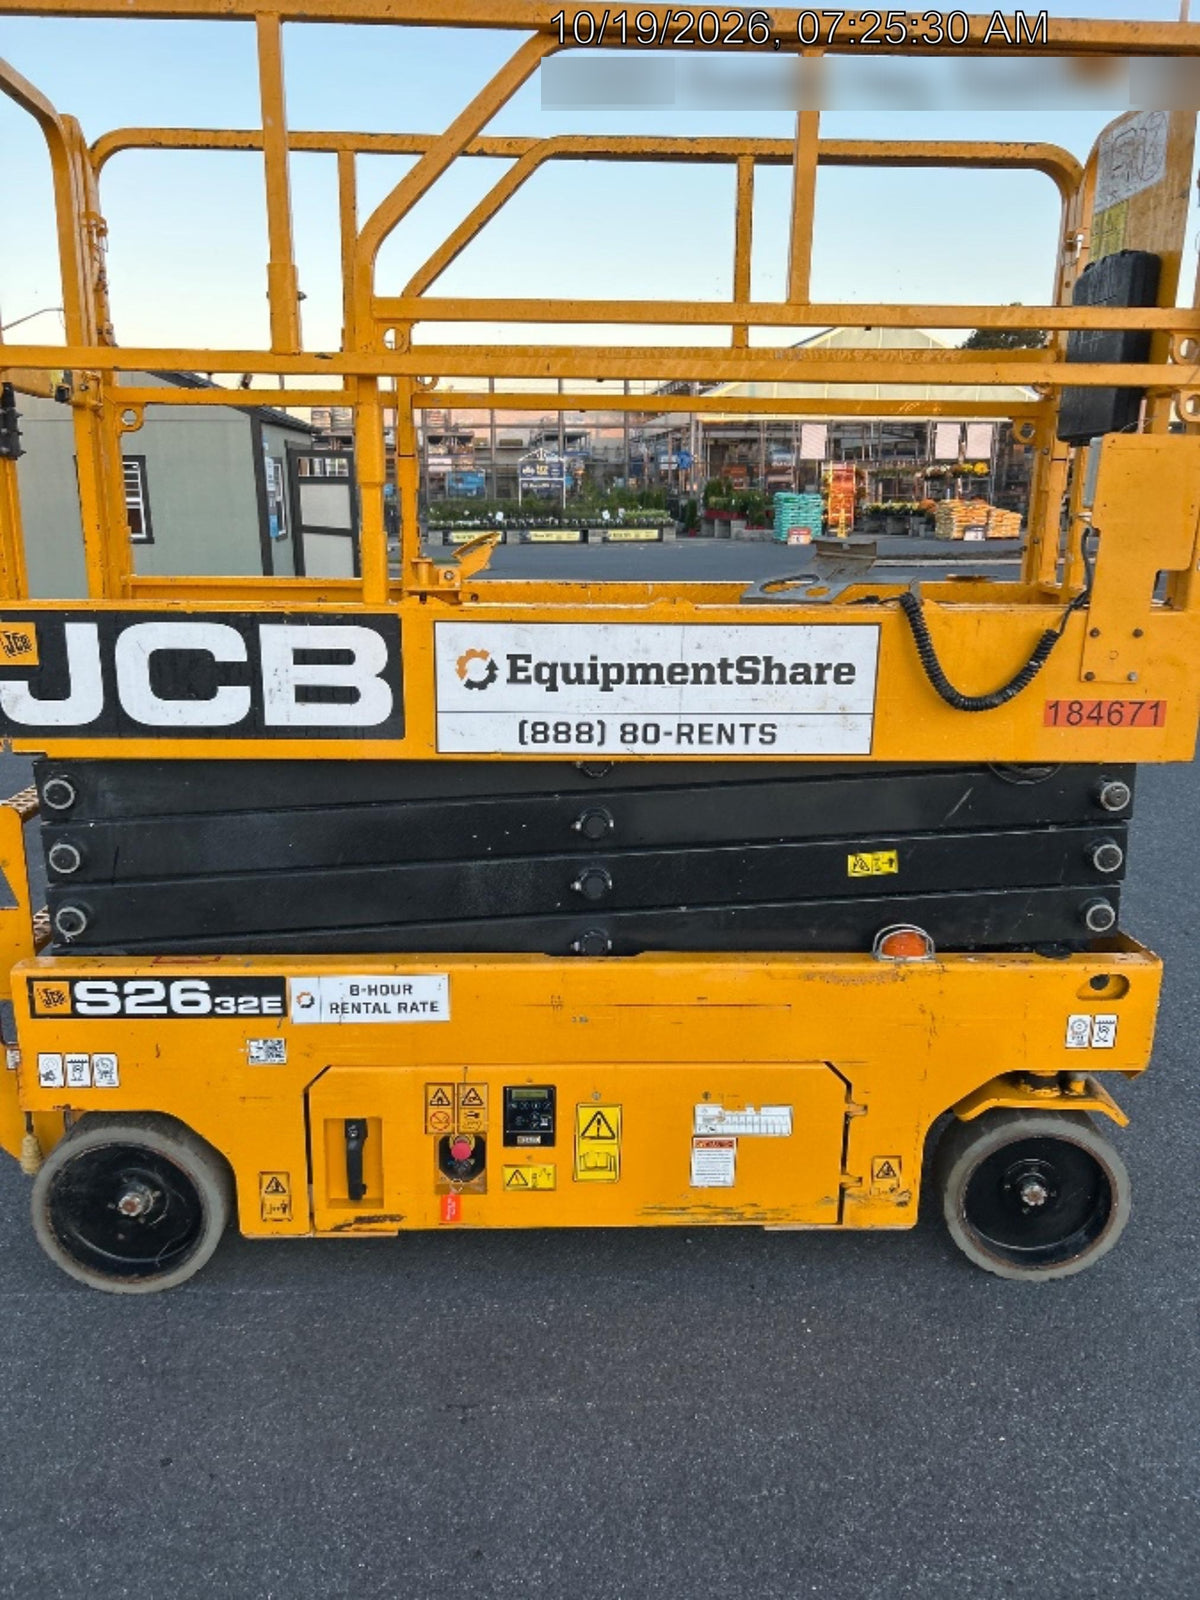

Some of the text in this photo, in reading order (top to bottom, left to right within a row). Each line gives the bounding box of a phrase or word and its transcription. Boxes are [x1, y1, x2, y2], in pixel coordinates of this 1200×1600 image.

[0, 621, 394, 726] JCB
[506, 654, 856, 692] EquipmentShare
[1048, 700, 1161, 726] 184671
[518, 720, 778, 746] (888) 80-RENTS
[330, 1001, 440, 1014] RENTAL RATE
